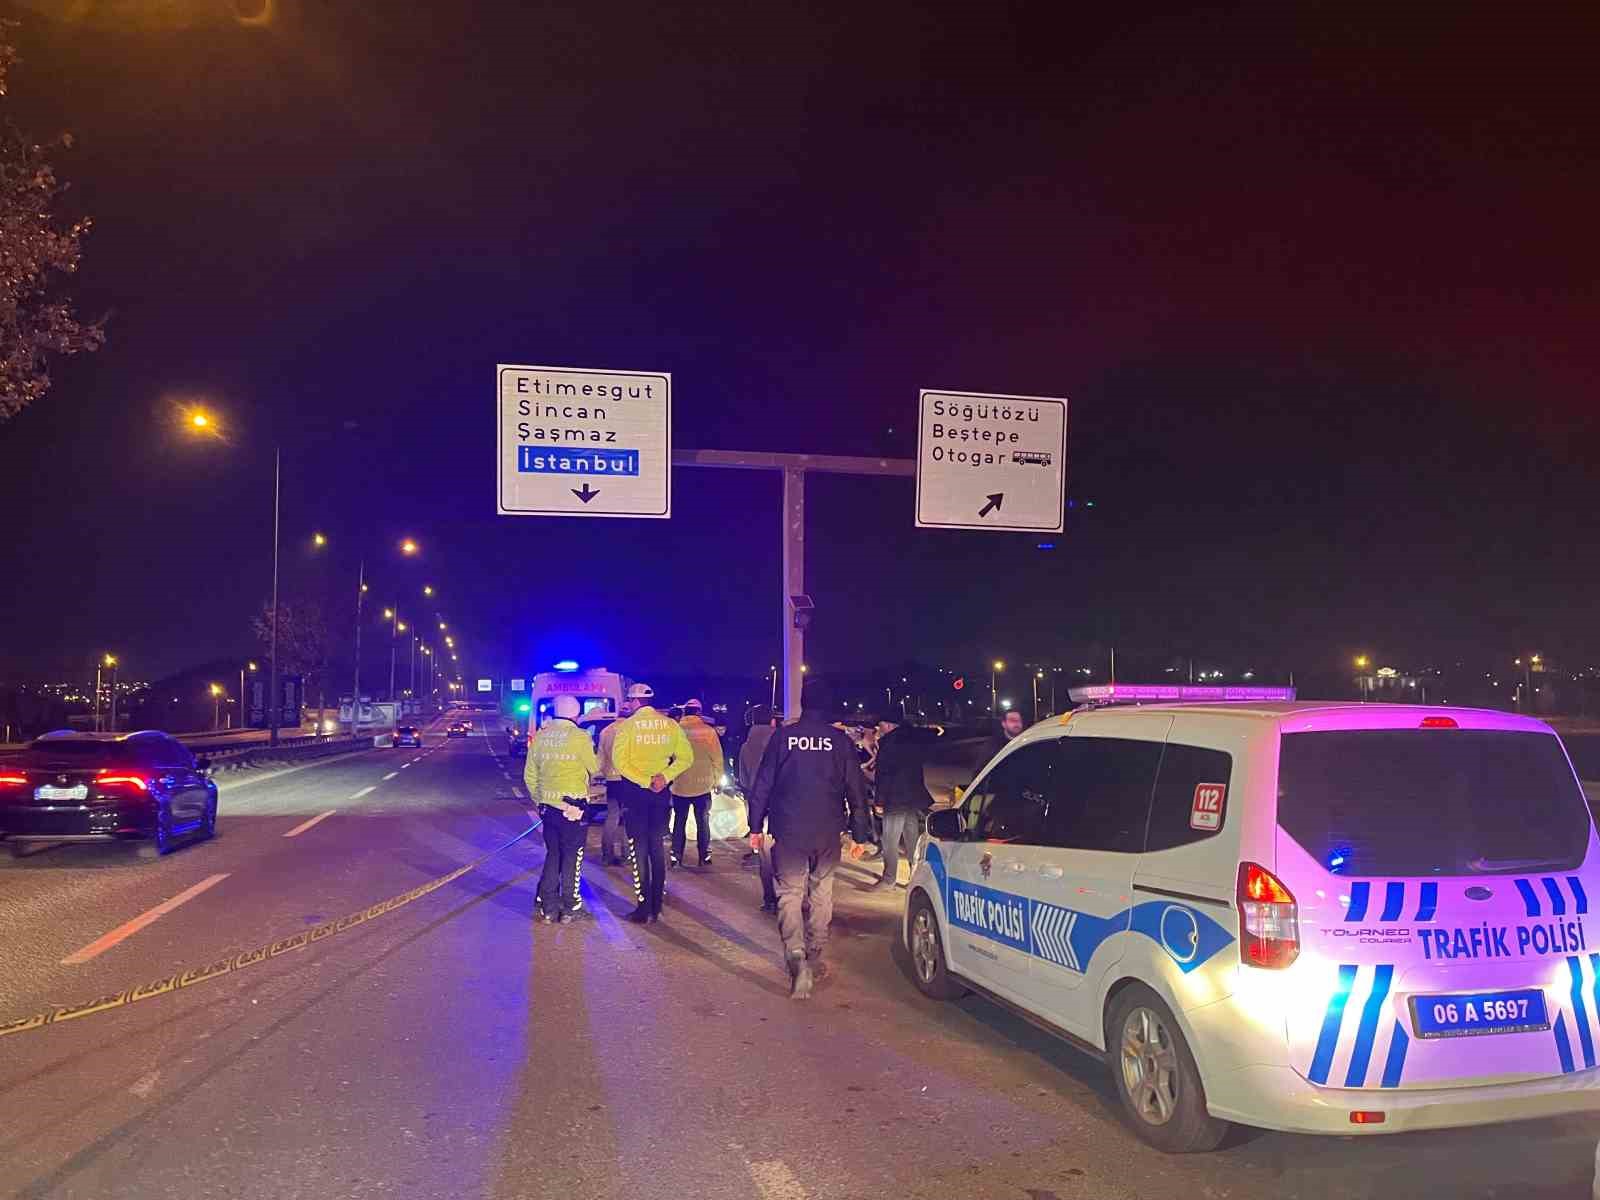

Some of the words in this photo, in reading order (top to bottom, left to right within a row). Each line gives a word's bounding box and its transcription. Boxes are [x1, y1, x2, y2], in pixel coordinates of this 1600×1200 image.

[517, 377, 653, 401] Etimesgut
[518, 400, 606, 419] Sincan
[934, 400, 1039, 422] Söğütözü
[518, 422, 617, 442] Şaşmaz
[932, 424, 1020, 446] Beştepe
[524, 447, 634, 472] İstanbul
[932, 446, 1006, 466] Otogar
[1198, 789, 1219, 810] 112
[953, 889, 988, 929] TRAFİK
[987, 898, 1025, 942] POLİSİ
[1320, 928, 1410, 936] TOURNEO
[1417, 921, 1511, 959] TRAFİK
[1516, 916, 1586, 955] POLİSİ
[1433, 1003, 1459, 1024] 06
[1465, 1002, 1480, 1022] A
[1483, 999, 1529, 1021] 5697
